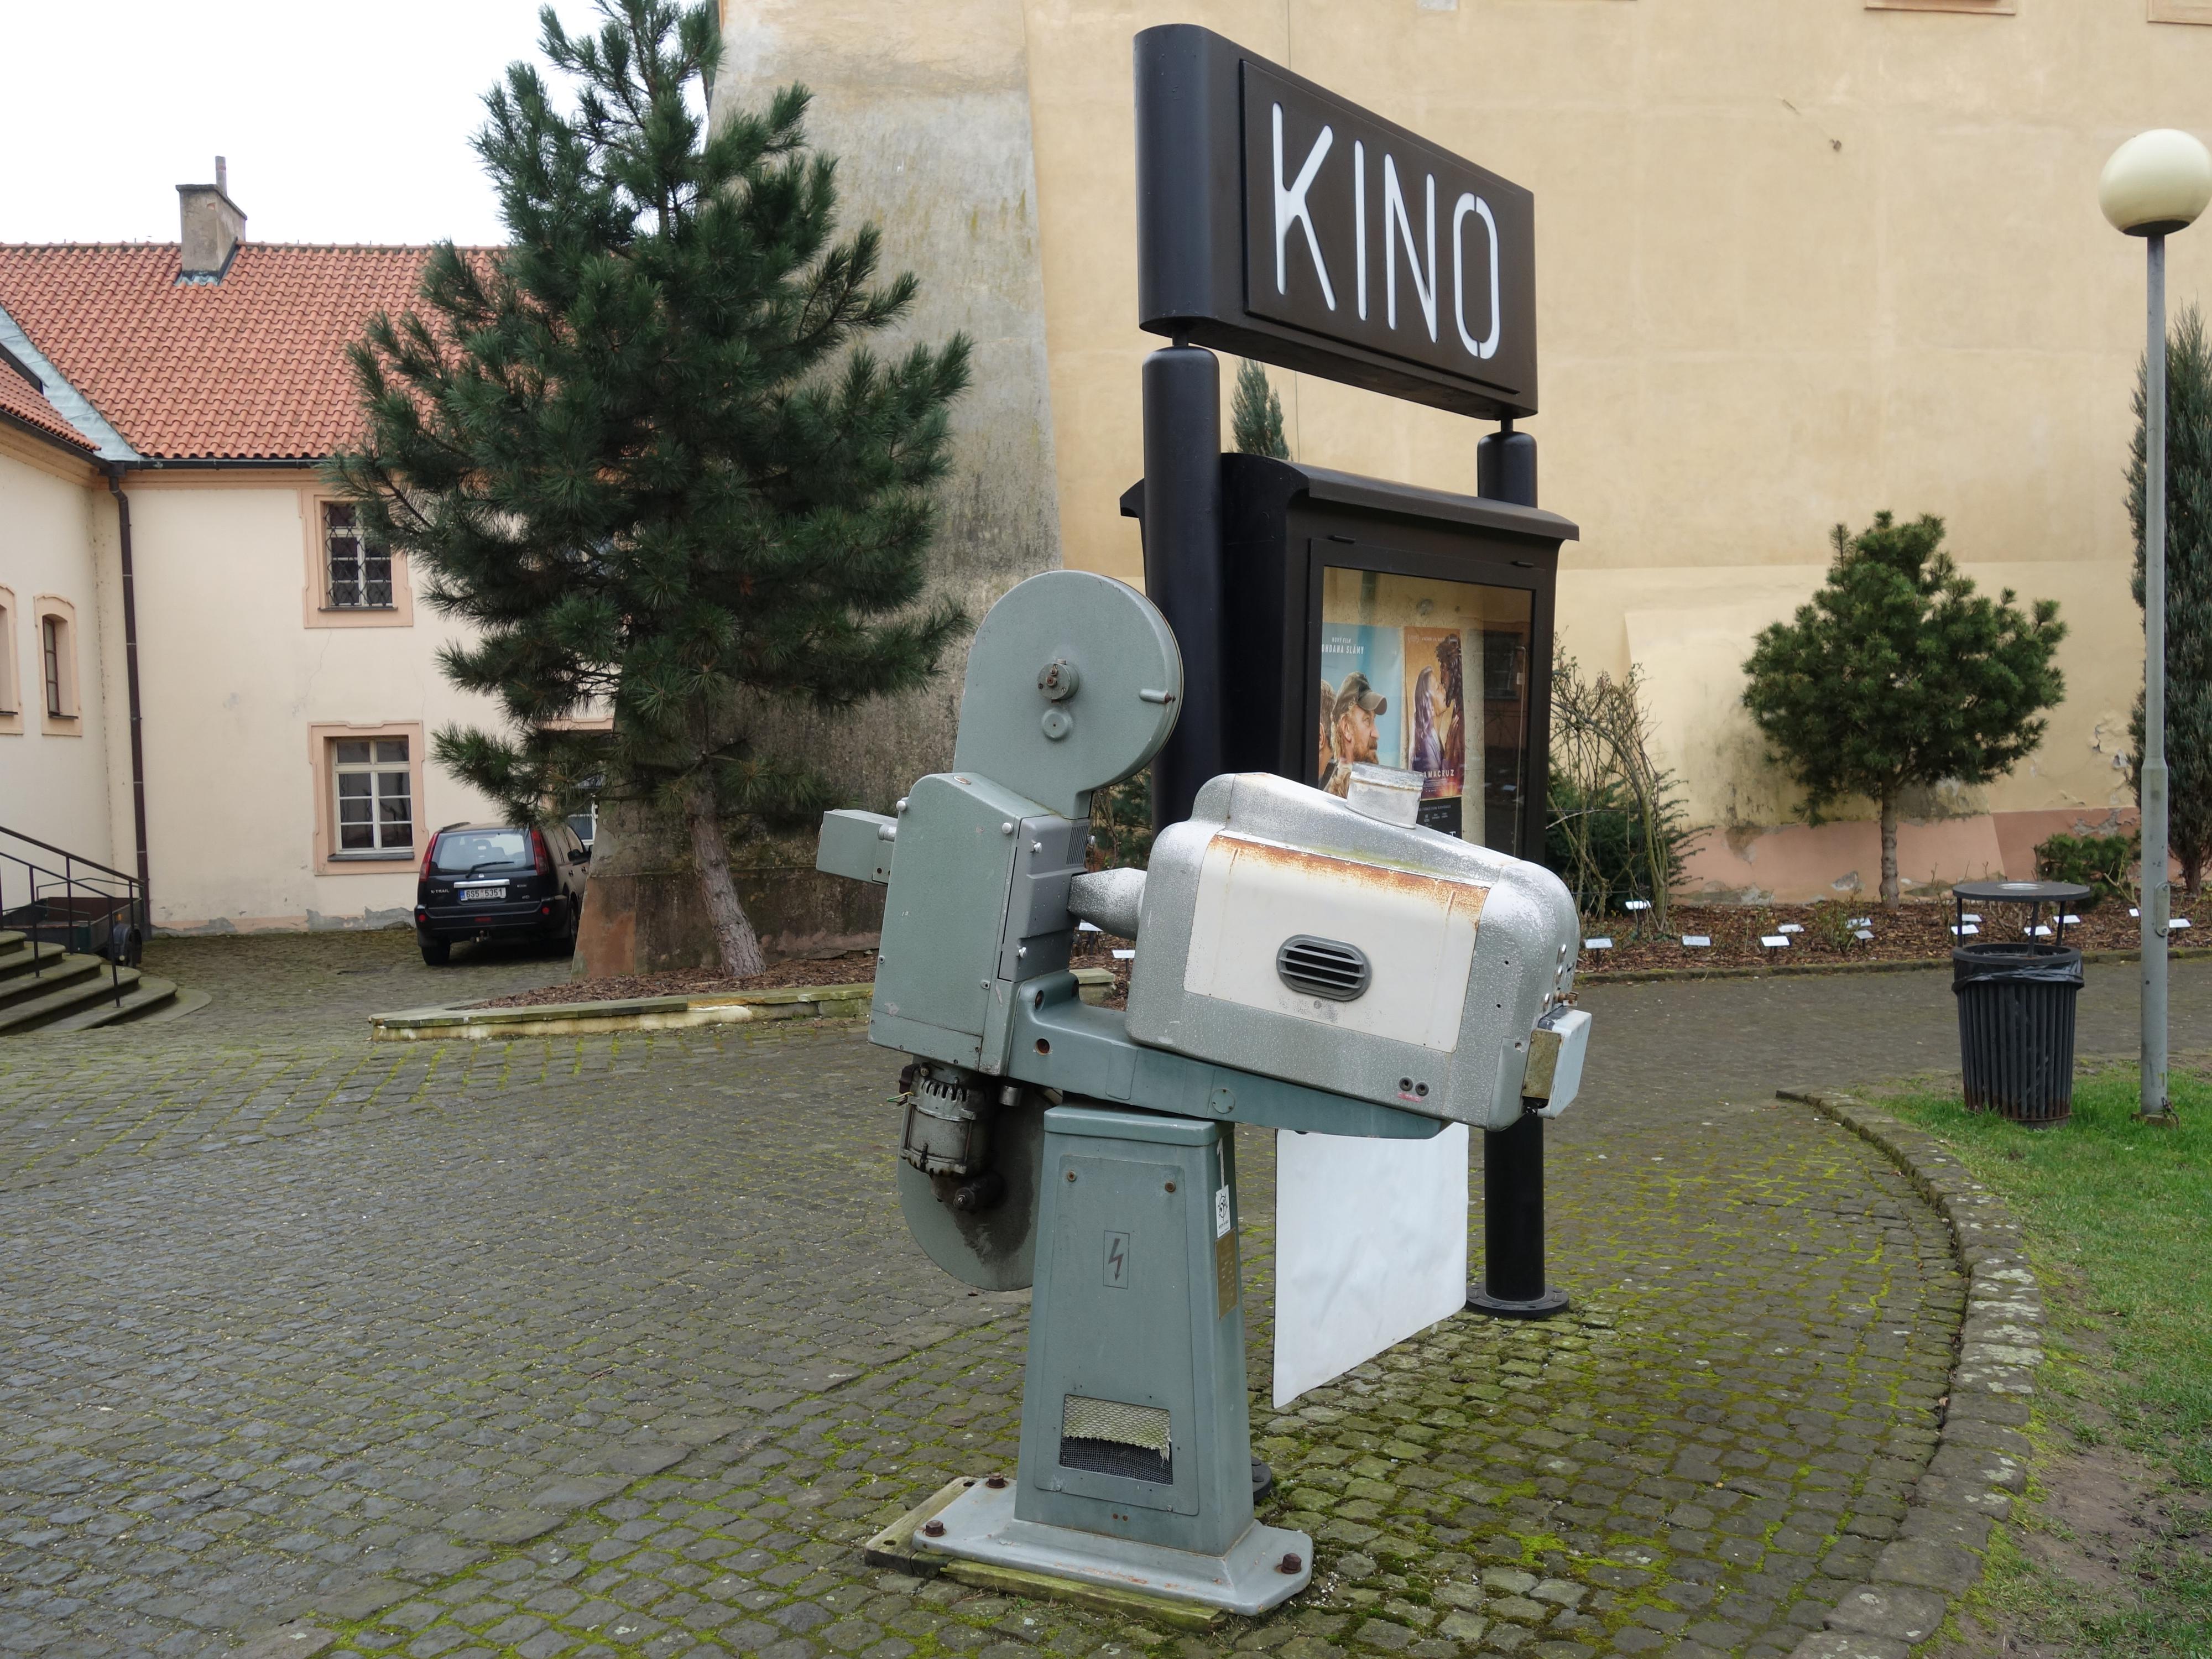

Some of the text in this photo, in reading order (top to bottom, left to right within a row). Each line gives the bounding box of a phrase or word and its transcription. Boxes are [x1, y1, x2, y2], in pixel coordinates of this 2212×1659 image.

[1272, 101, 1501, 360] KINO
[1322, 644, 1364, 654] OHDANA SLÁMY
[1424, 769, 1454, 778] AMACRUZ
[466, 890, 479, 898] 6S5
